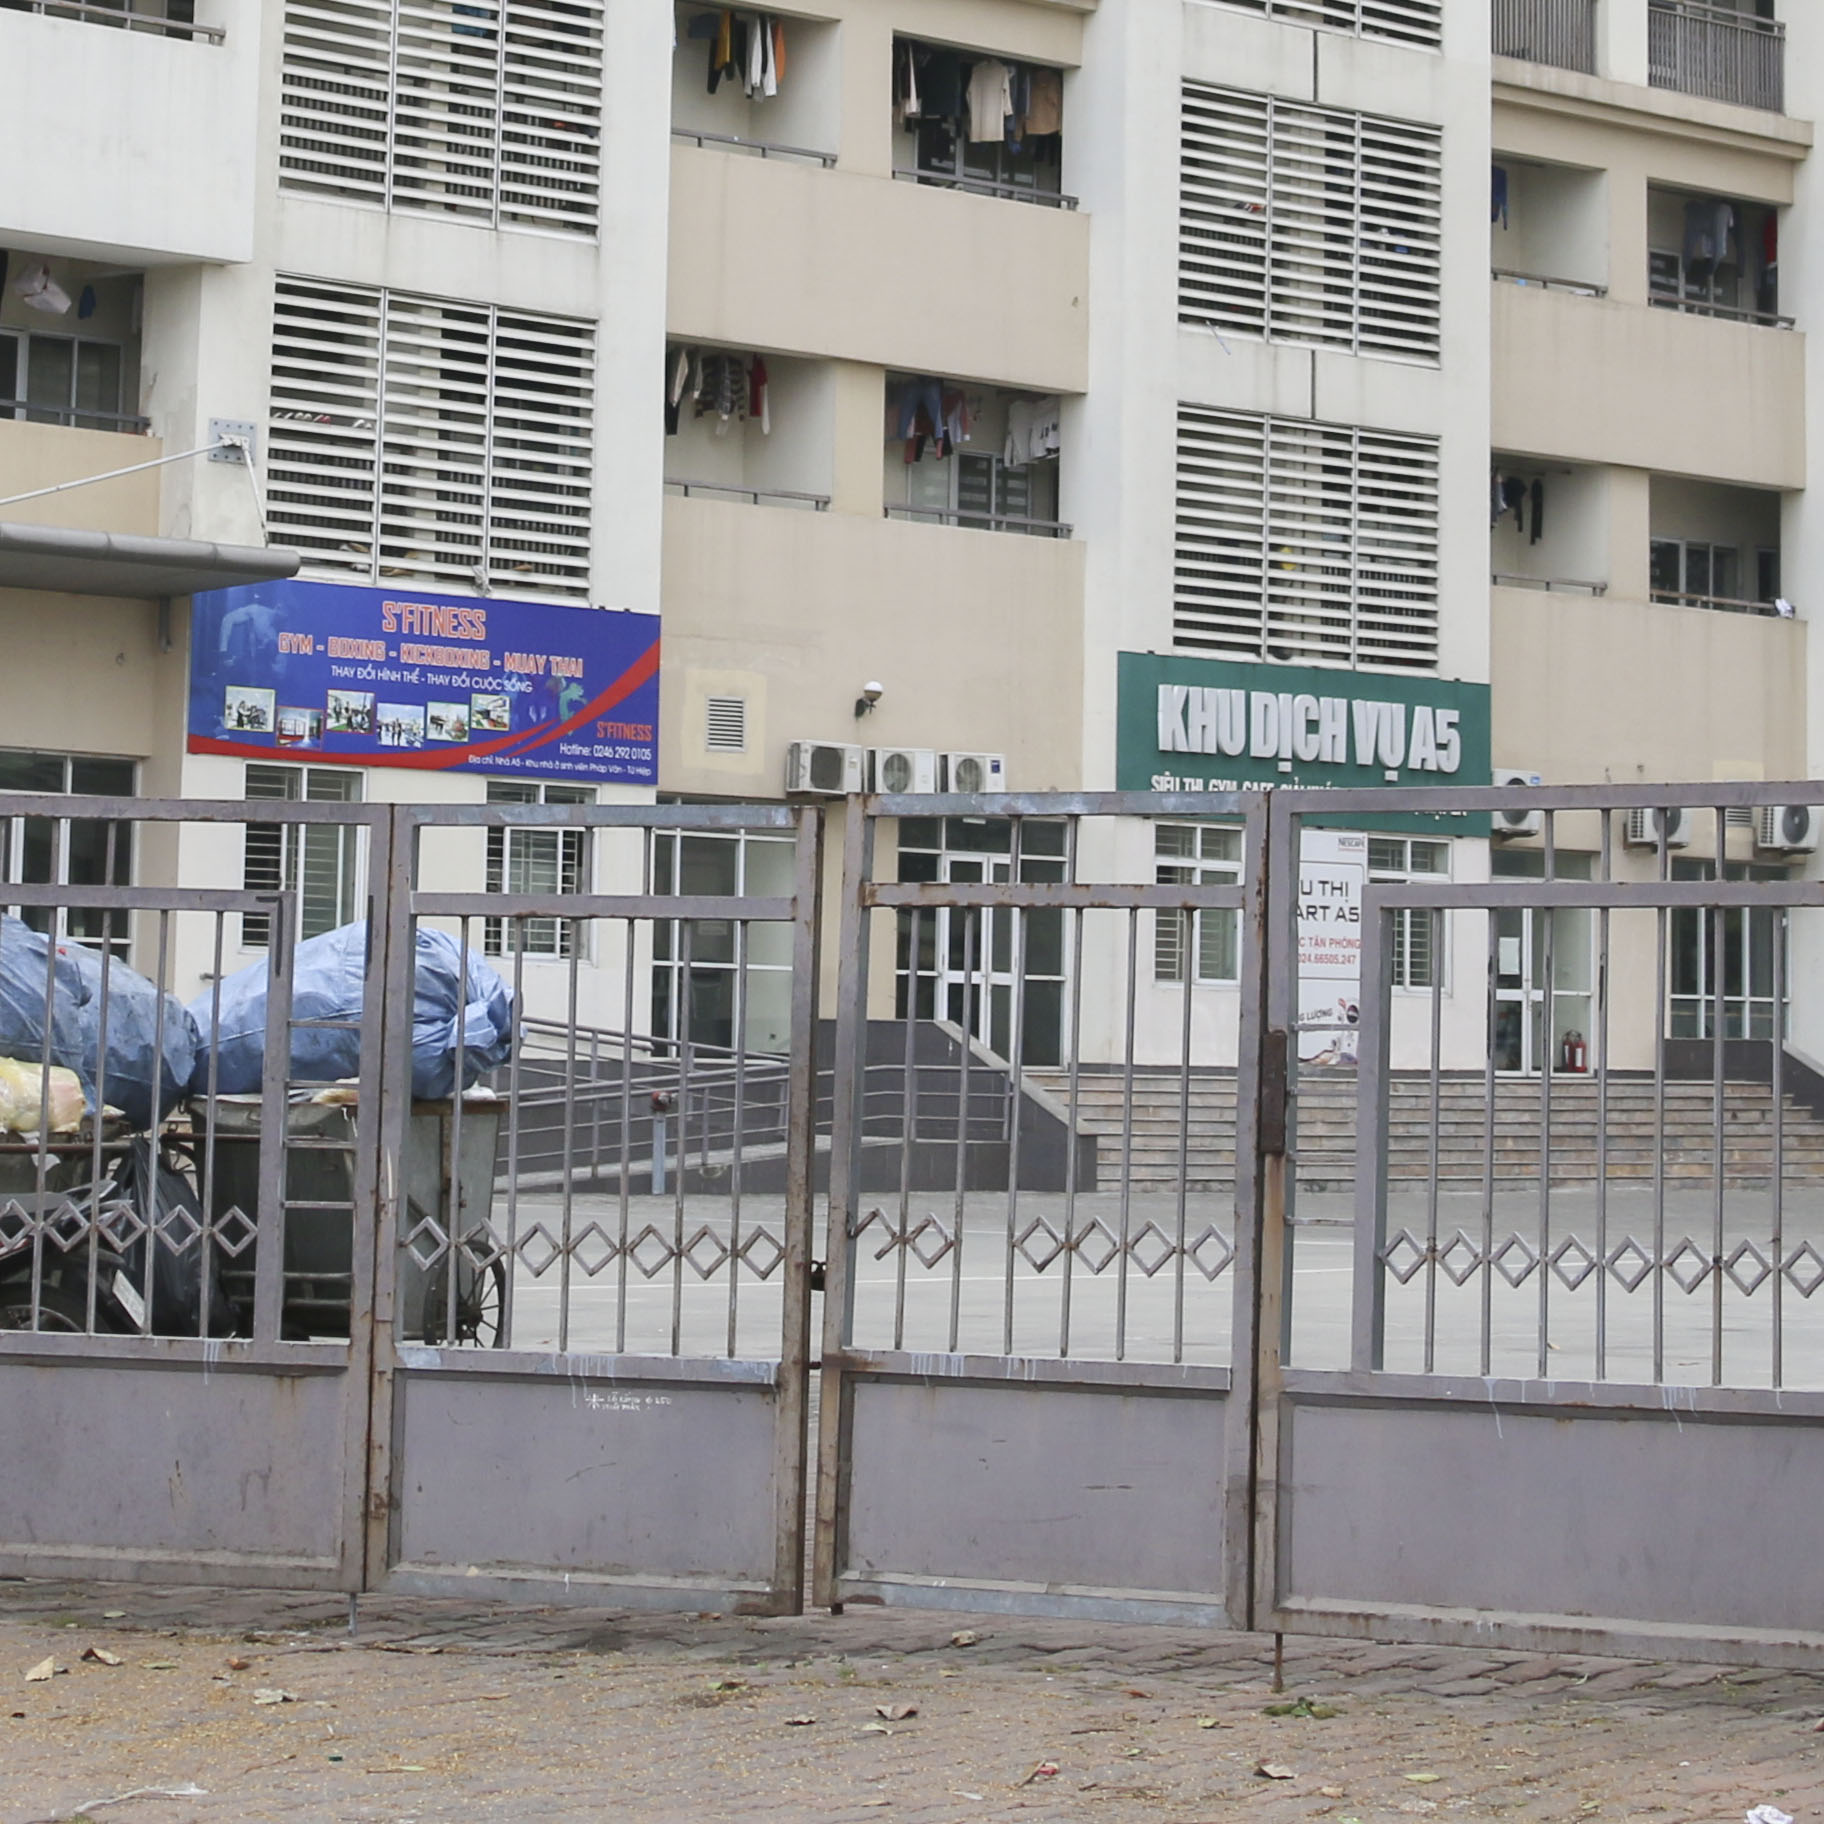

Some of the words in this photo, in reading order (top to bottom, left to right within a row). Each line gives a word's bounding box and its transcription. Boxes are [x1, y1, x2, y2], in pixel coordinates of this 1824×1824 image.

[382, 600, 487, 641] S'FITNESS
[278, 631, 314, 656] GYM
[327, 636, 386, 662] BOXING
[400, 642, 491, 670] KICKBOXING
[504, 651, 547, 676] MUAY
[548, 654, 584, 678] THAI
[330, 664, 355, 678] THAY
[357, 663, 376, 680] ĐỔI
[377, 667, 401, 683] HÌNH
[402, 667, 420, 684] THỂ
[427, 673, 451, 686] THAY
[451, 671, 470, 687] ĐỔI
[471, 676, 502, 692] CUỘC
[503, 675, 534, 693] SỐNG
[1157, 683, 1246, 757] KHU
[1249, 691, 1348, 773] DỊCH
[1352, 698, 1407, 782] VỤ
[1407, 704, 1462, 774] A5
[1318, 880, 1350, 903] THỊ
